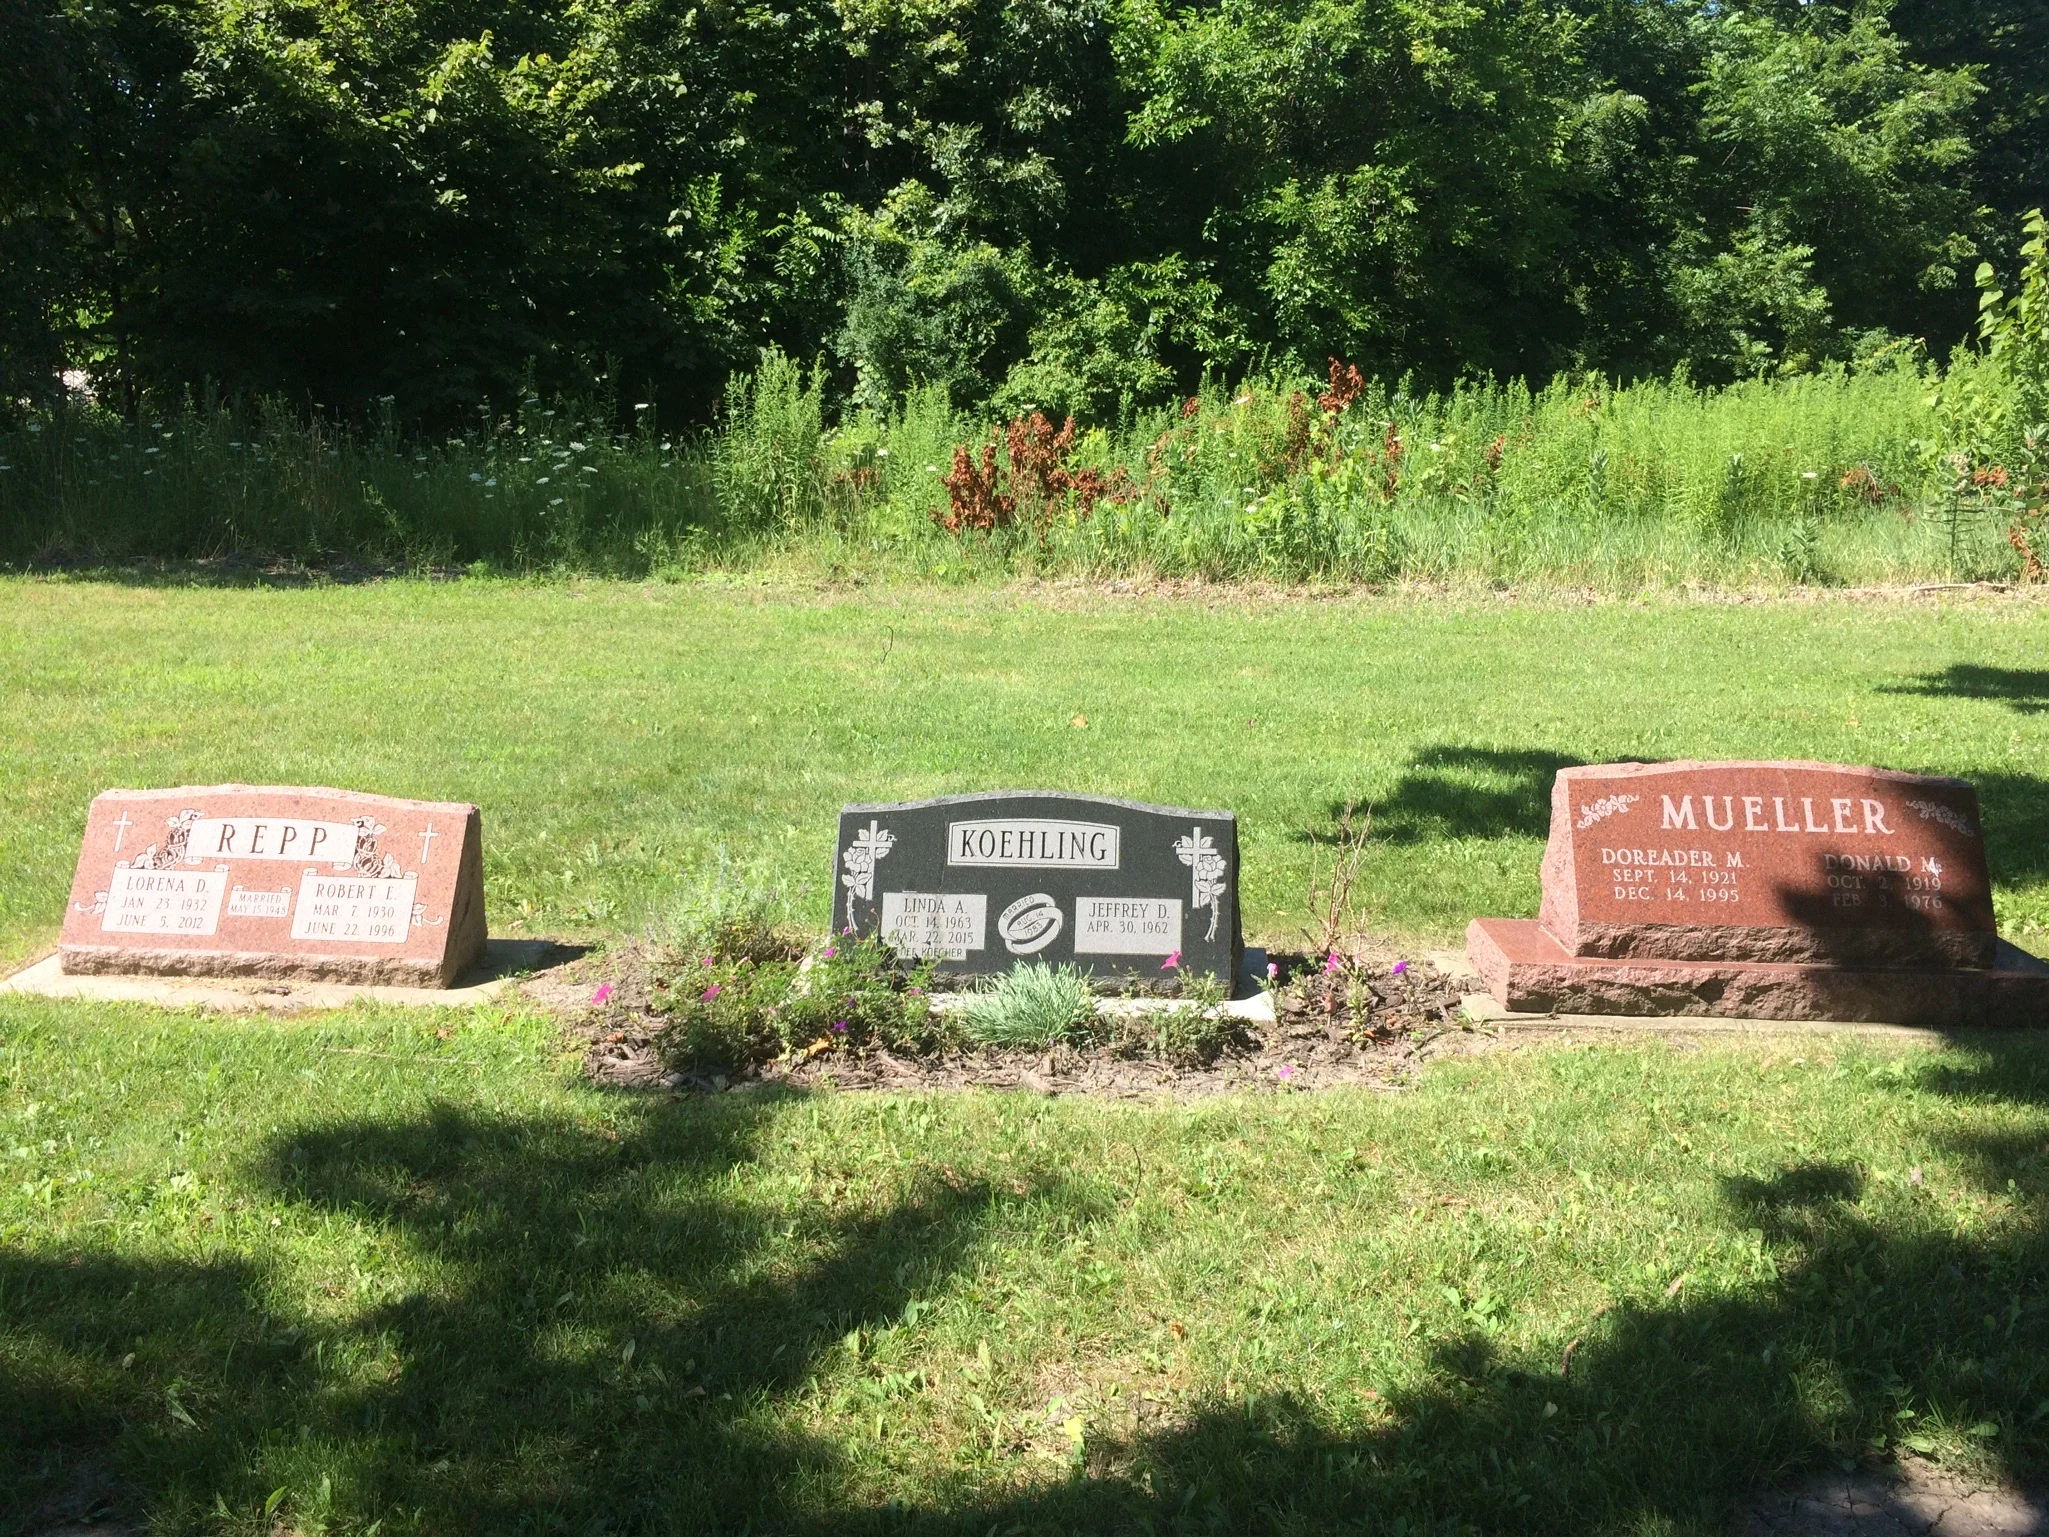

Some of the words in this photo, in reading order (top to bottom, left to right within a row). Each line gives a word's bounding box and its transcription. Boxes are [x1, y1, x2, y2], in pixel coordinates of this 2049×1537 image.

[1661, 794, 1896, 835] MUELLER
[217, 823, 328, 856] REPP
[961, 828, 1107, 861] KOEHLING
[1601, 848, 1717, 867] DOREADER
[1823, 853, 1912, 872] DONALD
[126, 876, 185, 892] LORENA
[1613, 869, 1658, 883] SEPT.
[1702, 871, 1737, 884] 1921
[1905, 877, 1942, 891] 1919
[239, 893, 282, 904] MARRIED
[315, 883, 376, 900] ROBERT
[1615, 886, 1654, 900] DEC.
[1700, 888, 1739, 902] 1995
[180, 898, 207, 911] 1932
[904, 897, 946, 913] LINDA
[1003, 896, 1035, 921] MARRIED
[1904, 895, 1942, 909] 1976
[368, 905, 395, 919] 1930
[1089, 903, 1149, 918] JEFFREY
[117, 914, 148, 927] JUNE
[178, 917, 204, 929] 2012
[946, 917, 972, 929] 1963
[1087, 920, 1113, 933] APR.
[1143, 921, 1168, 934] 1962
[304, 922, 336, 935] JUNE
[368, 924, 396, 937] 1996
[1024, 922, 1043, 937] 1983
[948, 932, 974, 944] 2015
